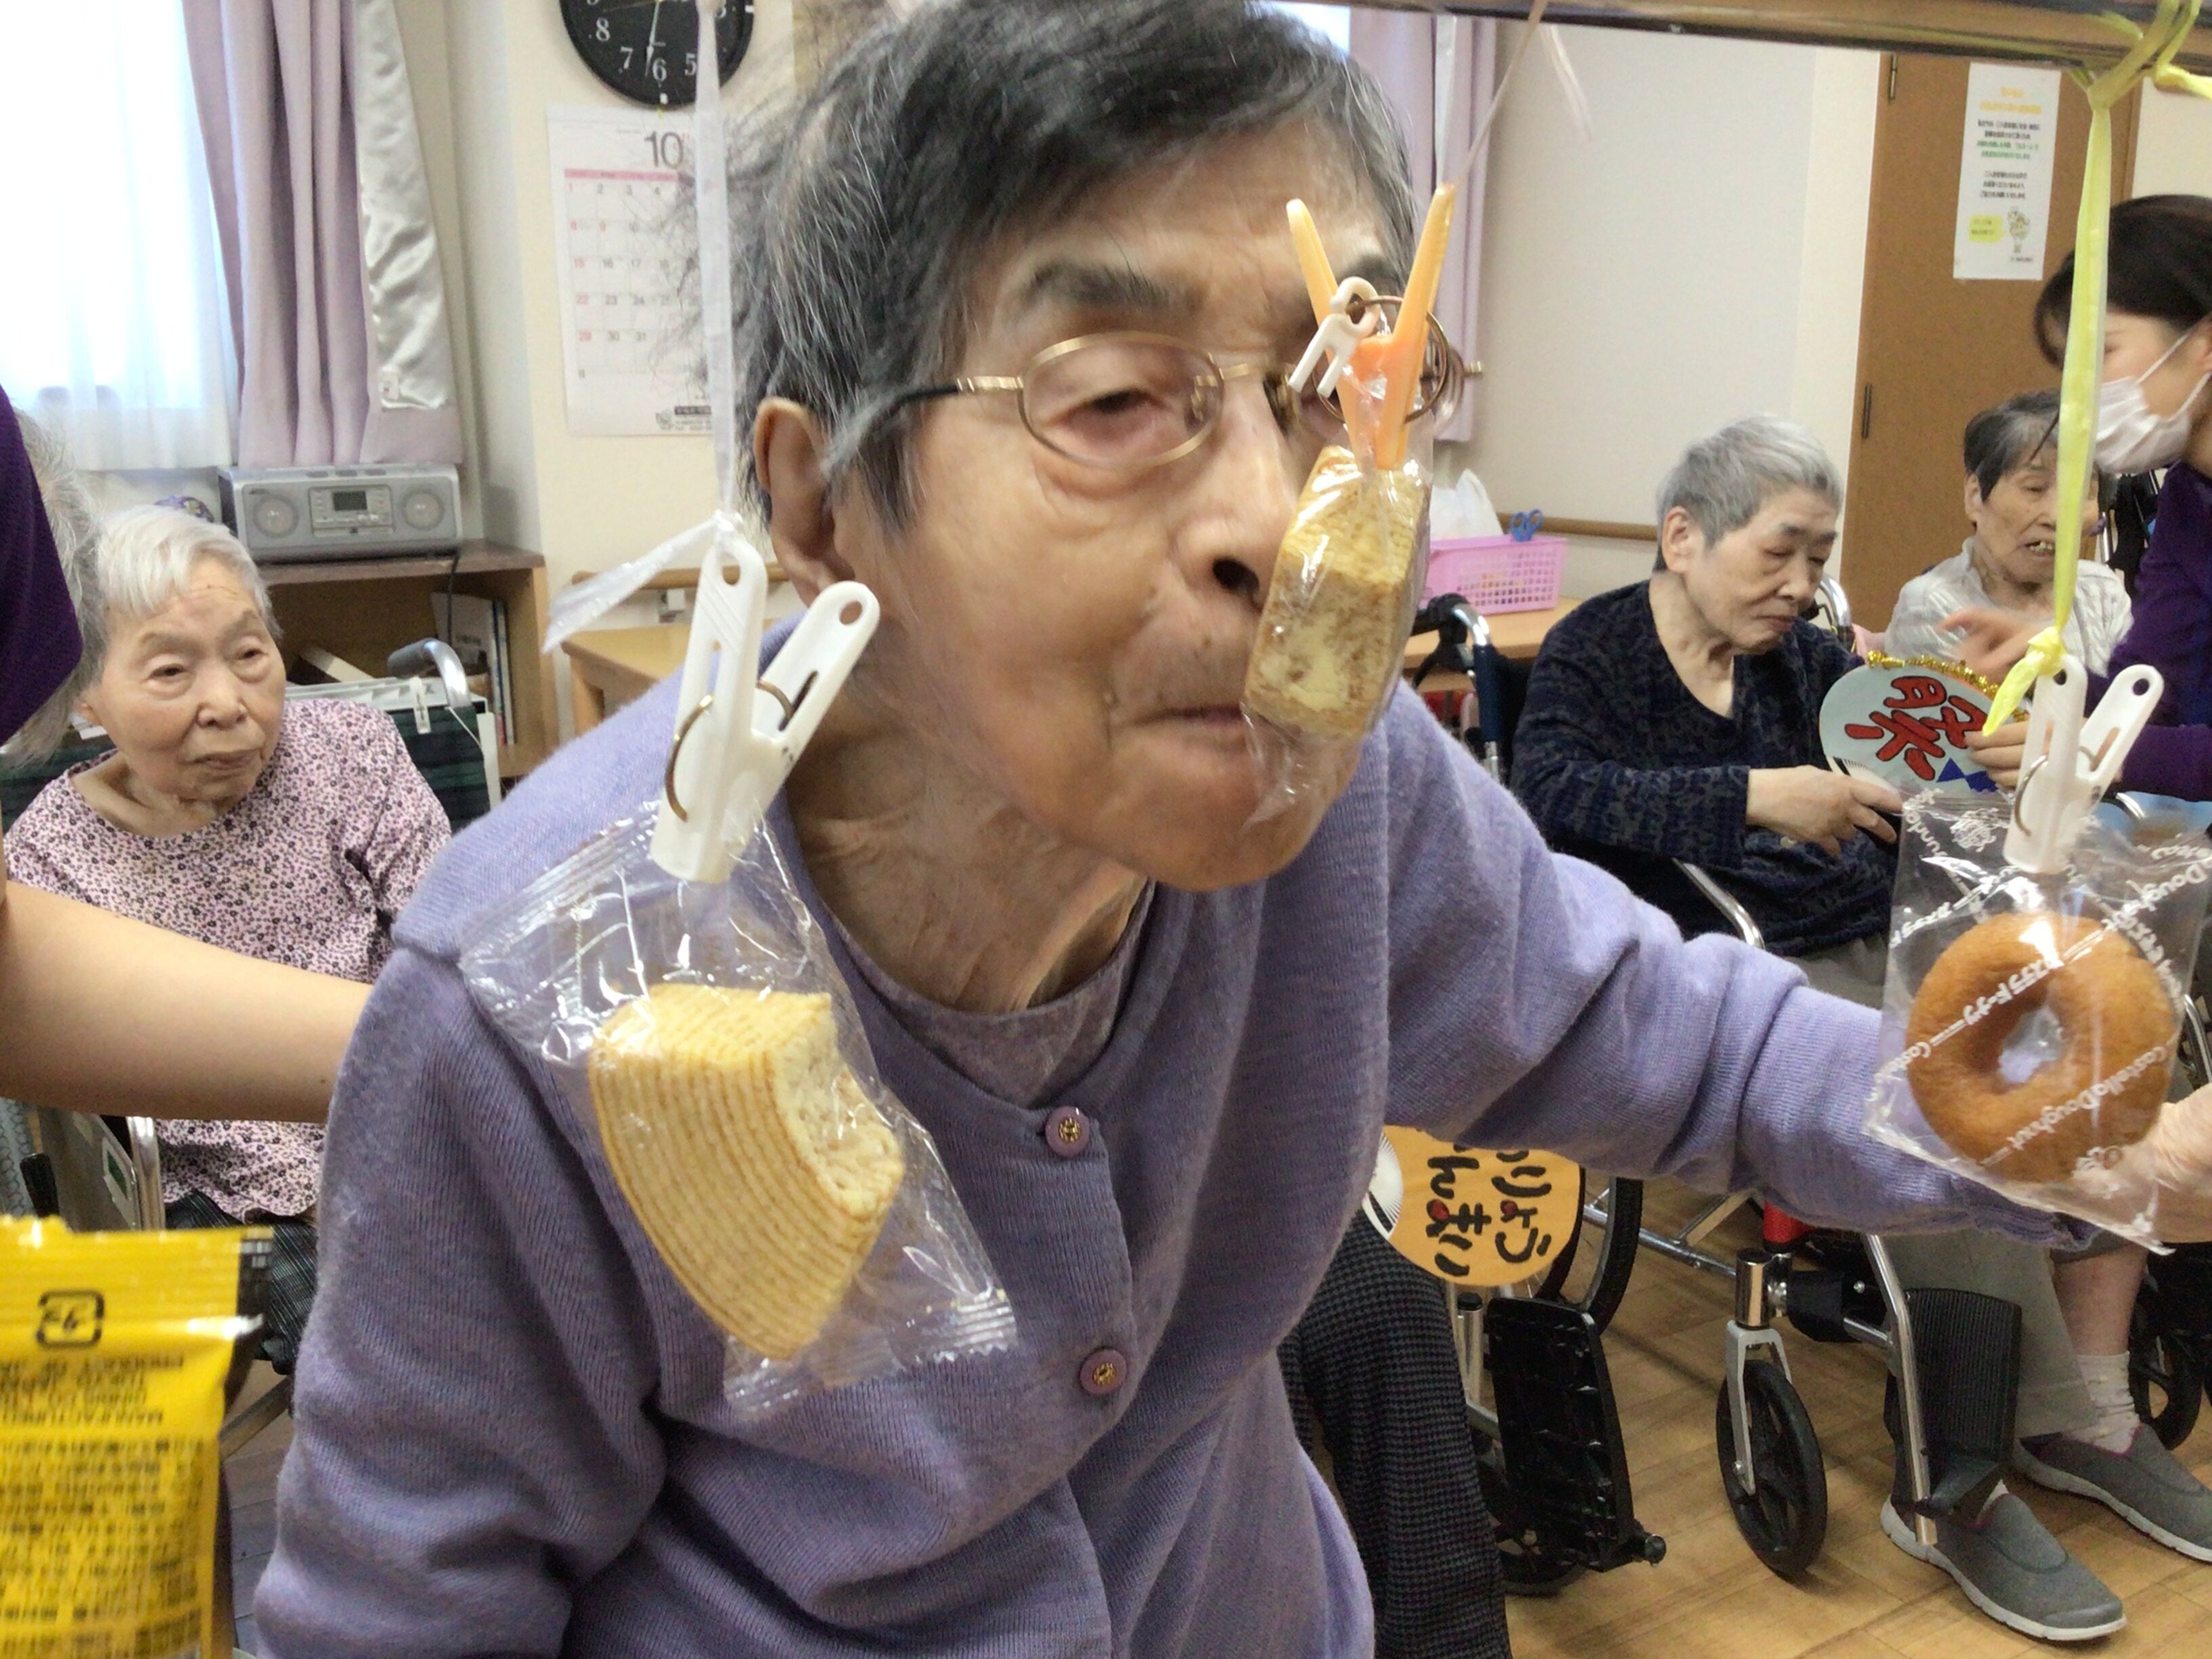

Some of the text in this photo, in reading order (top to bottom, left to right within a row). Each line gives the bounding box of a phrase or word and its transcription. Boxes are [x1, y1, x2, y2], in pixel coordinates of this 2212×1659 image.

[596, 18, 611, 42] 8
[619, 47, 634, 70] 7
[652, 58, 668, 82] 6
[684, 53, 697, 76] 5
[644, 131, 684, 169] 10
[1845, 676, 1990, 781] 祭
[1426, 1144, 1492, 1277] んまい
